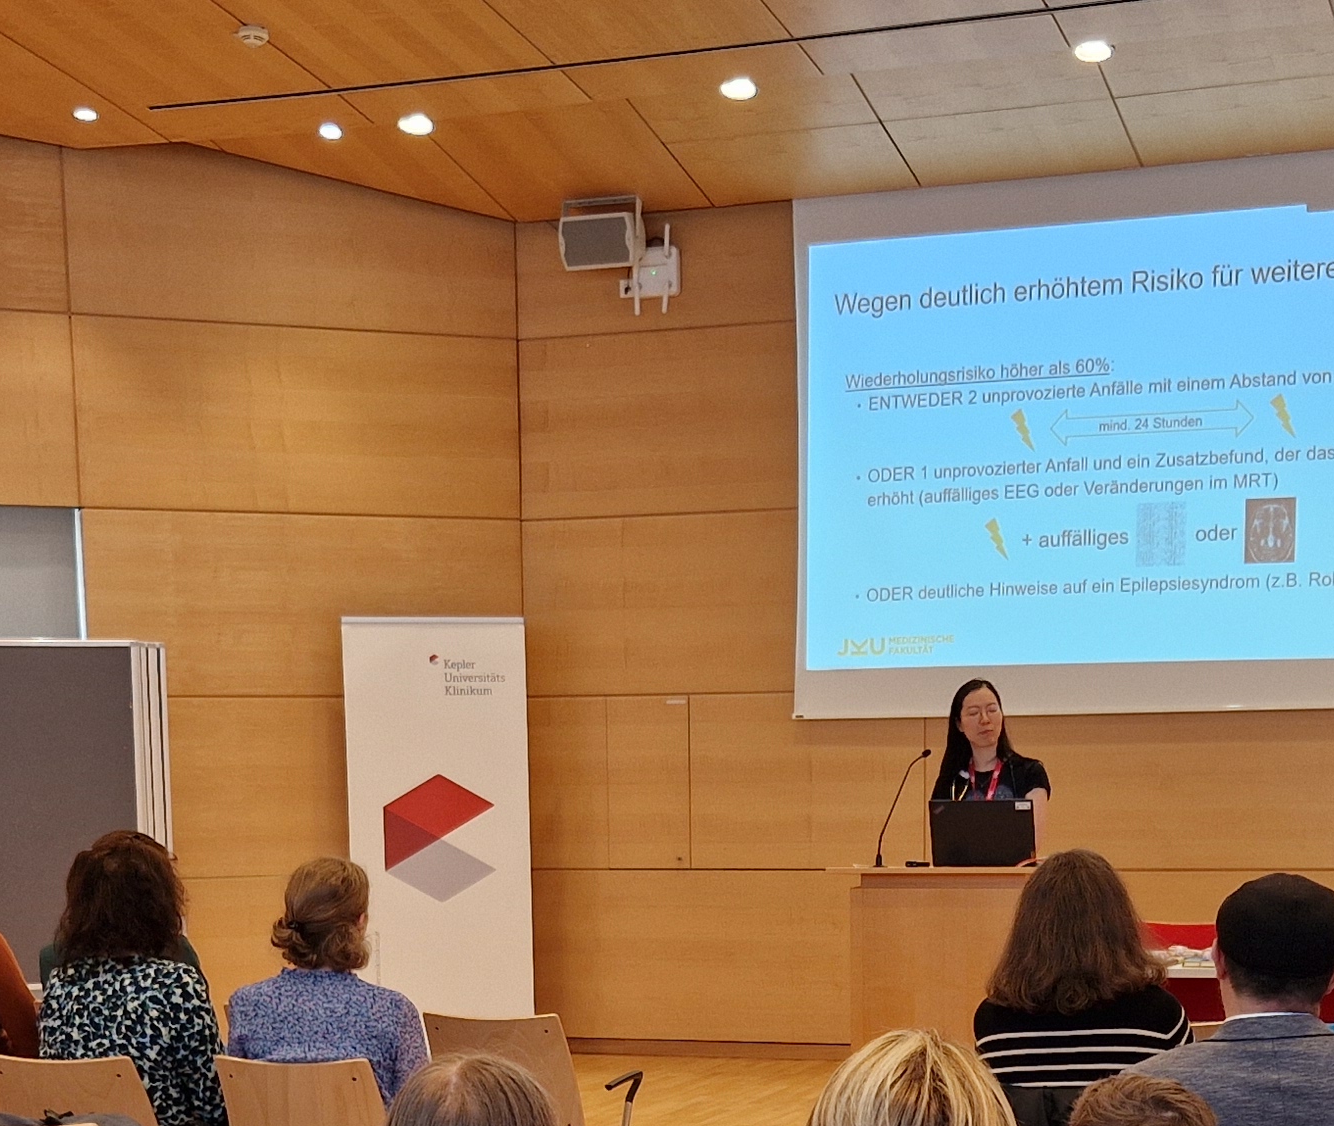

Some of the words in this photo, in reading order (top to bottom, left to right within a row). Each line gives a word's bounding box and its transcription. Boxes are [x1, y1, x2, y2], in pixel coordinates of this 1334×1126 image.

[834, 292, 911, 318] Wegen
[919, 281, 1005, 309] deutlich
[1014, 276, 1123, 302] erhöhtem
[1132, 268, 1204, 293] Risiko
[1212, 264, 1243, 288] für
[846, 364, 995, 389] Wiederholungsrisiko
[1001, 362, 1043, 380] höher
[1049, 360, 1070, 376] als
[1075, 357, 1114, 374] 60%:
[869, 391, 963, 411] ENTWEDER
[968, 390, 977, 405] 2
[983, 385, 1085, 406] unprovozierte
[1090, 380, 1143, 398] Anfälle
[1149, 377, 1172, 394] mit
[1177, 376, 1225, 391] einem
[1229, 371, 1297, 389] Abstand
[1302, 371, 1332, 385] von
[1099, 418, 1131, 432] mind.
[1134, 417, 1149, 430] 24
[1153, 415, 1203, 429] Stunden
[868, 466, 915, 483] ODER
[921, 465, 928, 480] 1
[934, 461, 1041, 482] unprovozierter
[1045, 457, 1088, 473] Anfall
[1093, 455, 1122, 471] und
[1127, 454, 1150, 469] ein
[1156, 448, 1268, 468] Zusatzbefund,
[1274, 447, 1301, 462] der
[867, 490, 915, 507] erhöht
[918, 487, 999, 507] (auffälliges
[1004, 483, 1040, 500] EEG
[1044, 482, 1078, 498] oder
[1083, 477, 1203, 496] Veränderungen
[1209, 475, 1228, 490] im
[1233, 472, 1278, 491] MRT)
[1039, 529, 1129, 550] auffälliges
[1195, 524, 1238, 542] oder
[867, 586, 913, 602] ODER
[918, 583, 984, 599] deutliche
[989, 580, 1058, 597] Hinweise
[1063, 579, 1088, 595] auf
[1092, 578, 1114, 593] ein
[1120, 574, 1260, 595] Epilepsiesyndrom
[1265, 572, 1301, 591] (z.B.
[888, 634, 955, 646] MEDIZINISCHE
[888, 644, 934, 655] FAKULTÄT
[443, 659, 476, 672] Kepler
[443, 672, 506, 683] Universitäts
[444, 685, 493, 696] Klinikum
